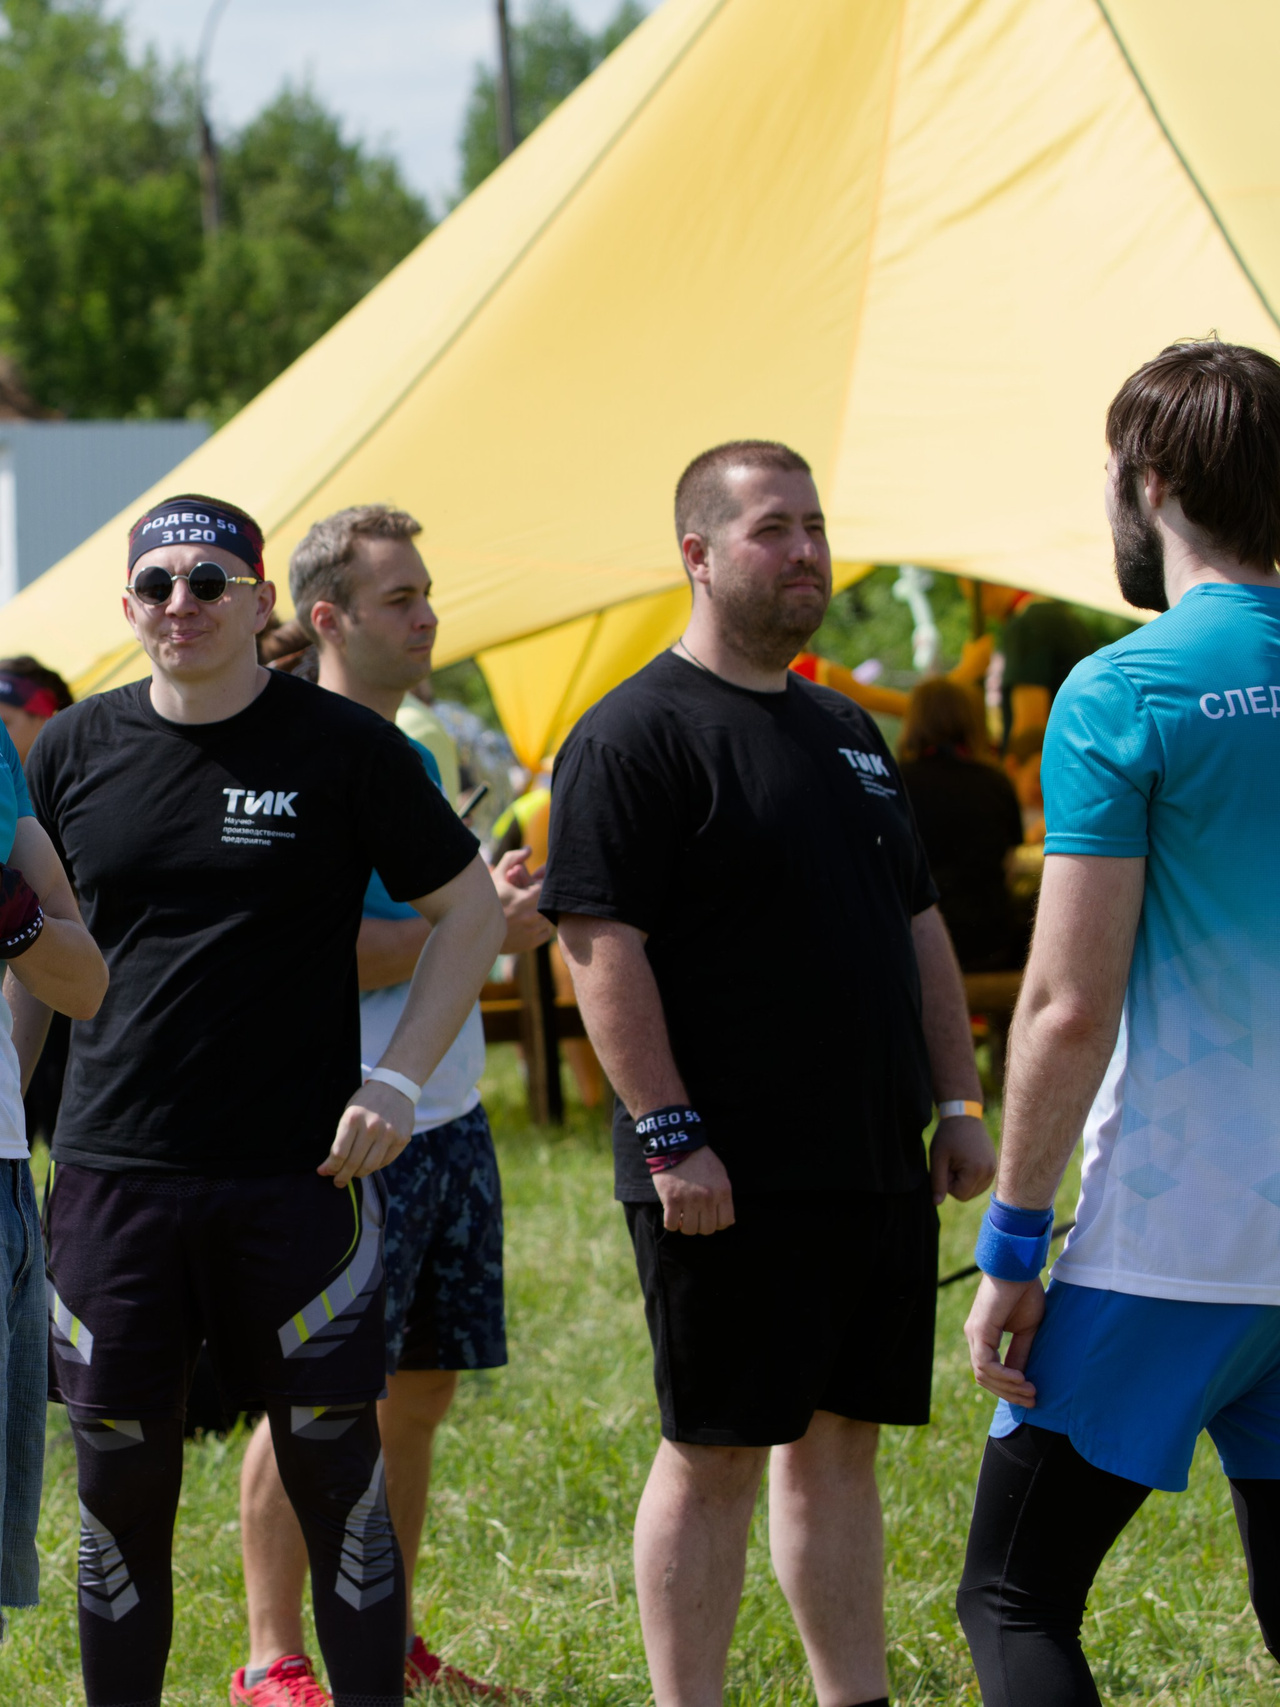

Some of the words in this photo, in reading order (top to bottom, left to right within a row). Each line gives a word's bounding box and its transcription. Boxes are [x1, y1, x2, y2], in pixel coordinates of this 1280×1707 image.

[142, 512, 211, 535] РОДЕО
[216, 518, 238, 535] 59
[161, 528, 216, 543] 3120
[222, 787, 299, 817] ТИК
[223, 816, 255, 826] Научно-
[222, 826, 296, 839] производственное
[221, 835, 272, 847] предприятие
